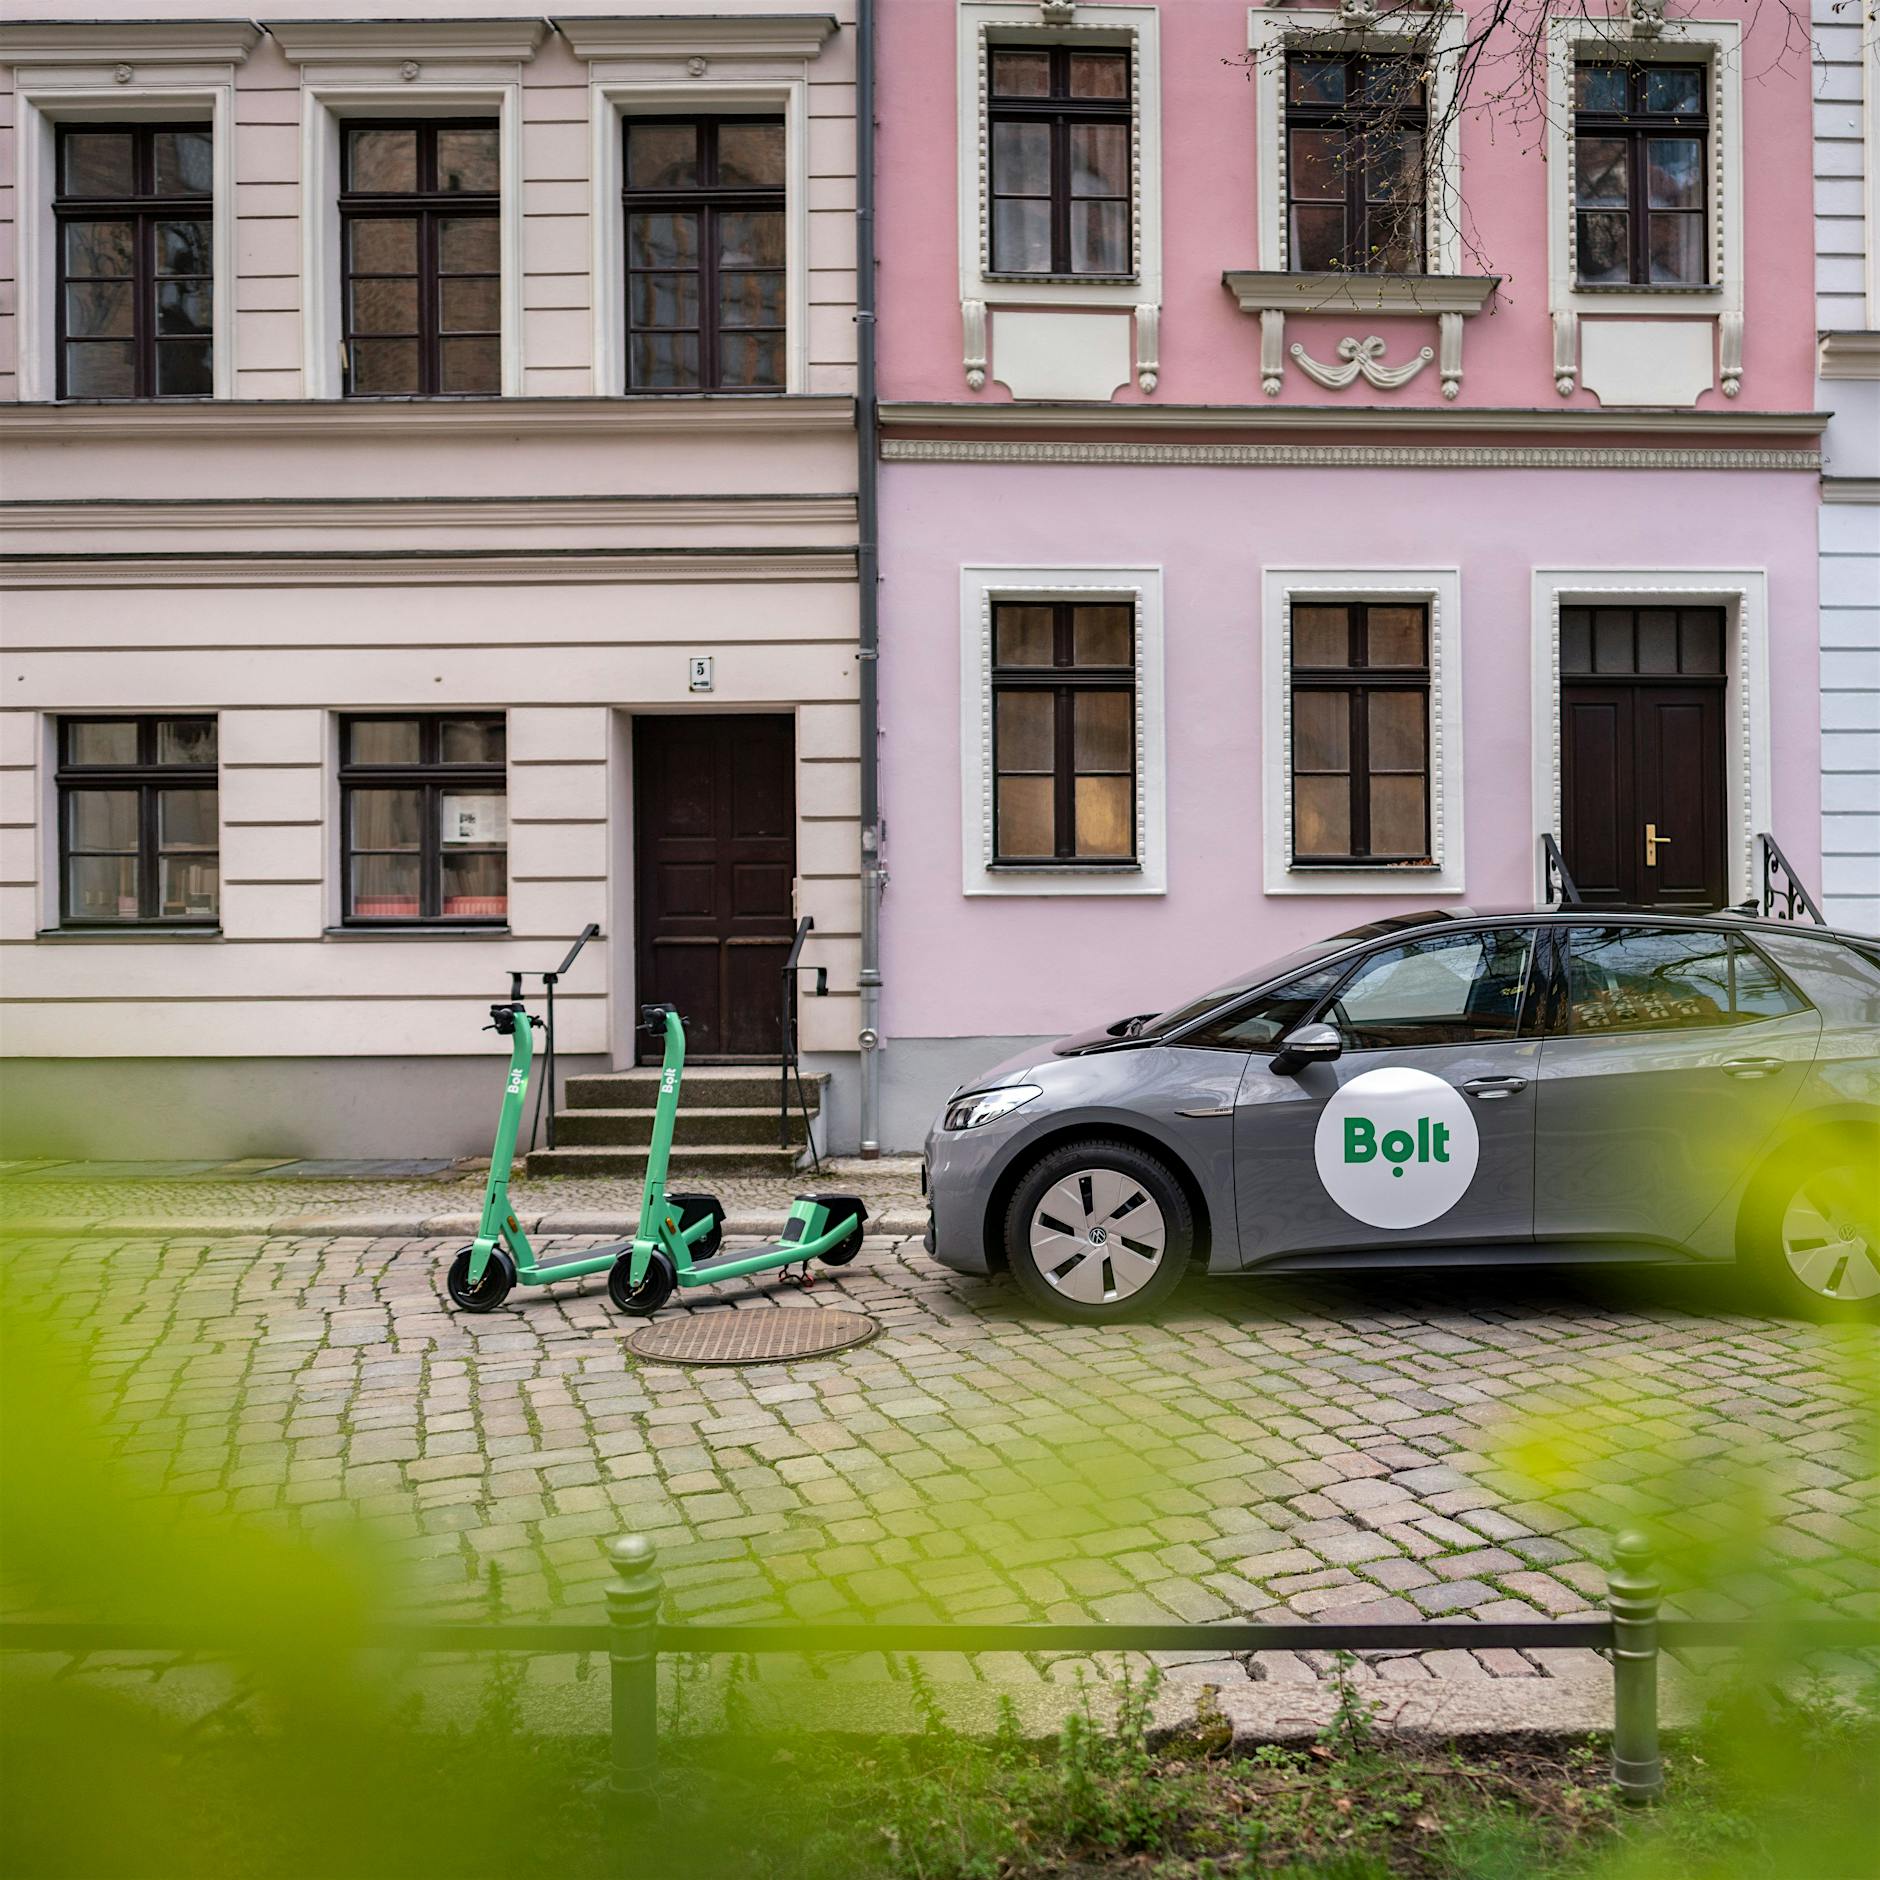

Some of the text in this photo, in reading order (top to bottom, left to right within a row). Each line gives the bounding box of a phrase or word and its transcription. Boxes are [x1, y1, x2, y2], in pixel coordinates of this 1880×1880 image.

[697, 662, 704, 675] 5
[508, 1068, 524, 1093] Bolt
[662, 1068, 678, 1093] Bolt
[1344, 1117, 1450, 1178] Bolt
